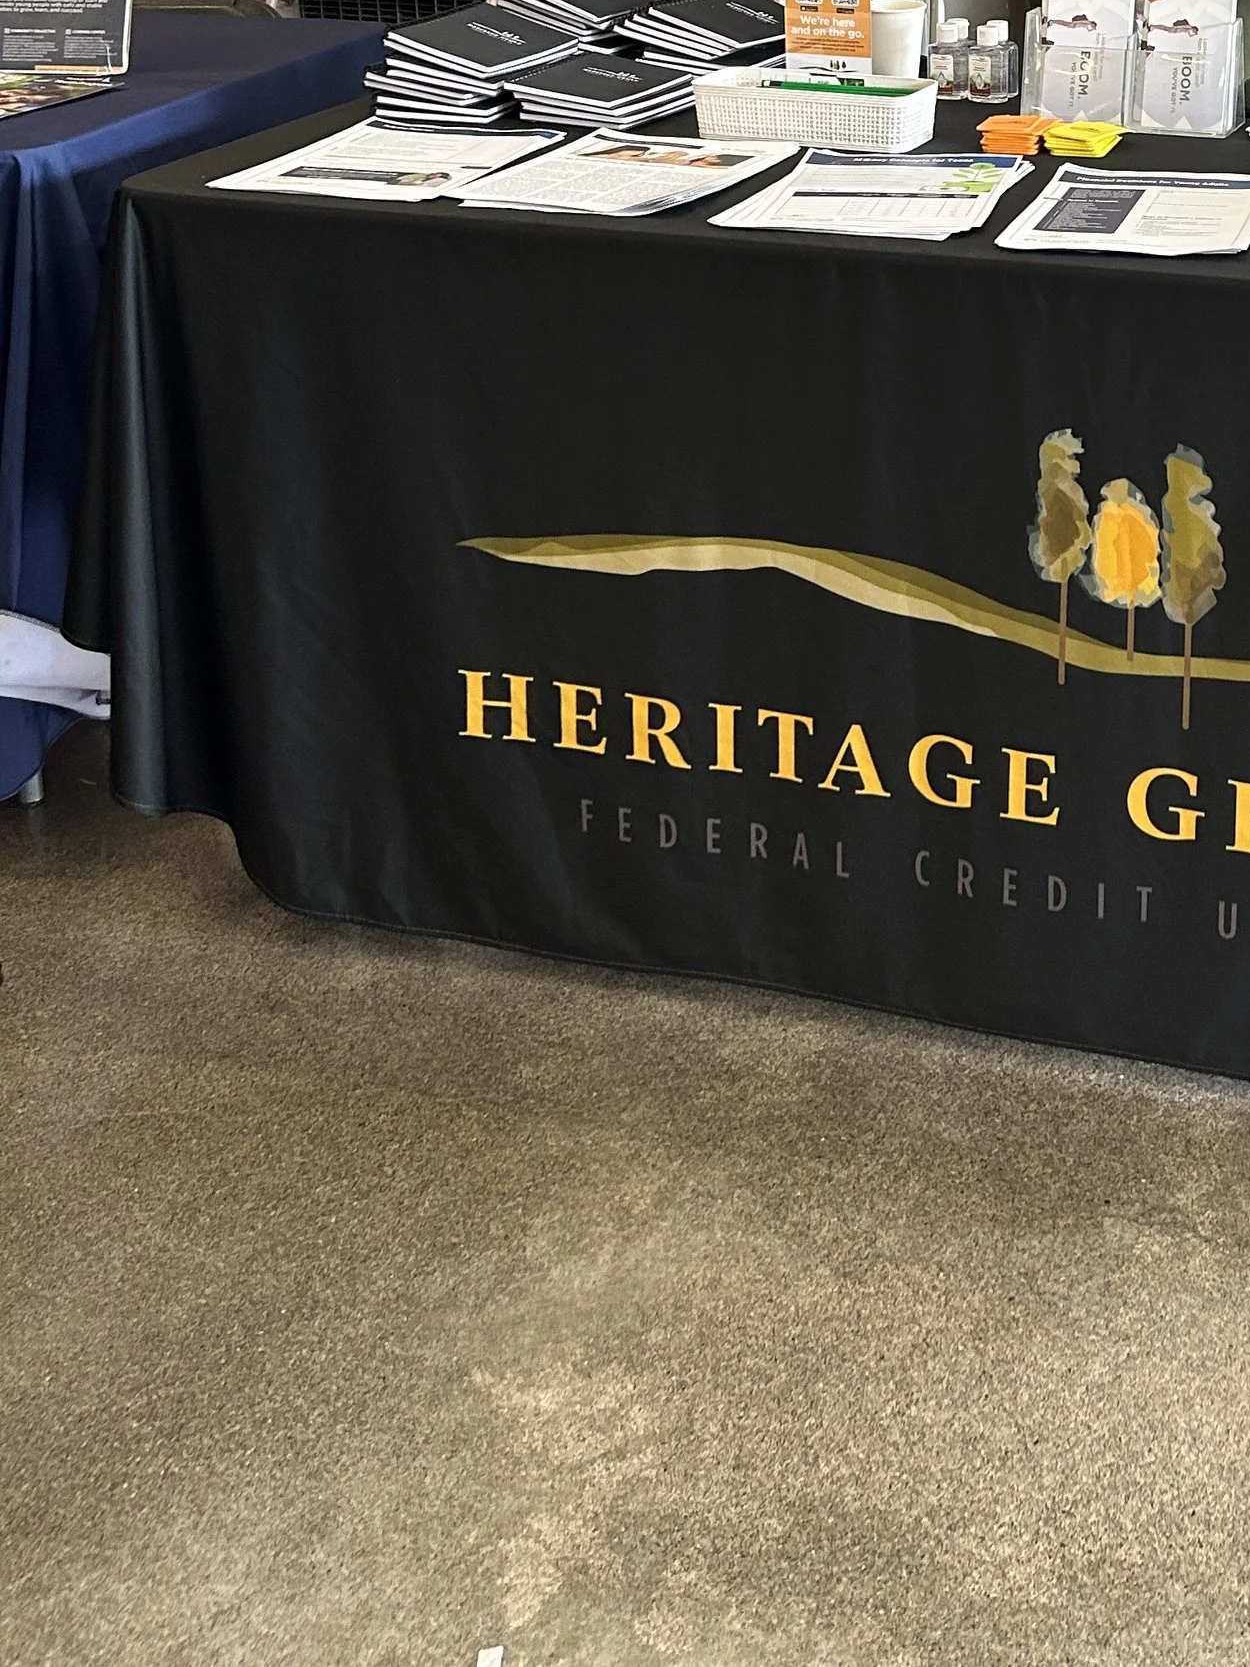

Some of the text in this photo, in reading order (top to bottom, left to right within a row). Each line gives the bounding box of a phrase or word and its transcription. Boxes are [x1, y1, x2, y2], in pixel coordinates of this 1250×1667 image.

[791, 26, 811, 35] and
[829, 28, 846, 37] the
[848, 30, 865, 39] go.
[800, 15, 856, 27] We're here
[1178, 56, 1193, 106] BOOM.
[457, 668, 1061, 826] HERITAGE
[580, 798, 850, 878] FEDERAL
[914, 850, 1153, 922] CREDIT
